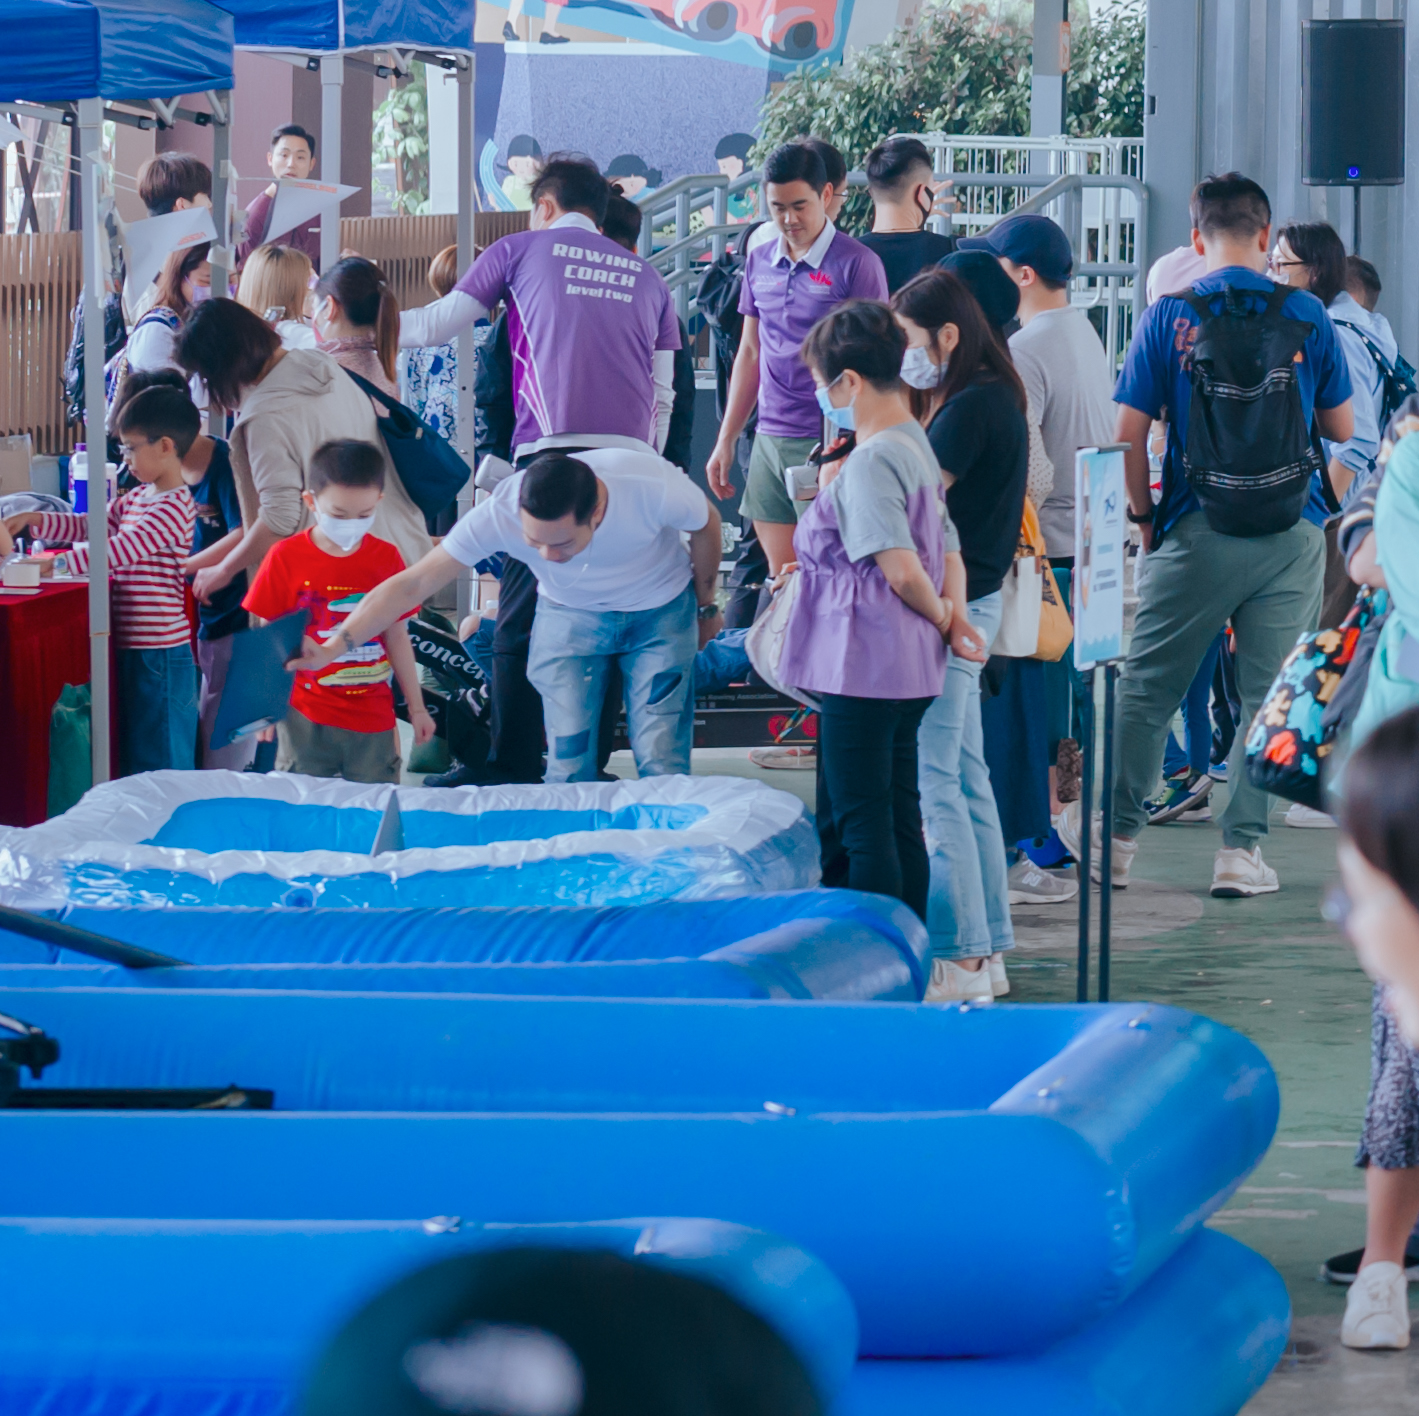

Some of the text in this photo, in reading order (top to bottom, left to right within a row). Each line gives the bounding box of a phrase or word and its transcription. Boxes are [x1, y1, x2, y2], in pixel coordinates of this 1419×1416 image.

[552, 243, 643, 273] ROWING
[564, 264, 636, 288] COACH
[566, 283, 633, 303] level two
